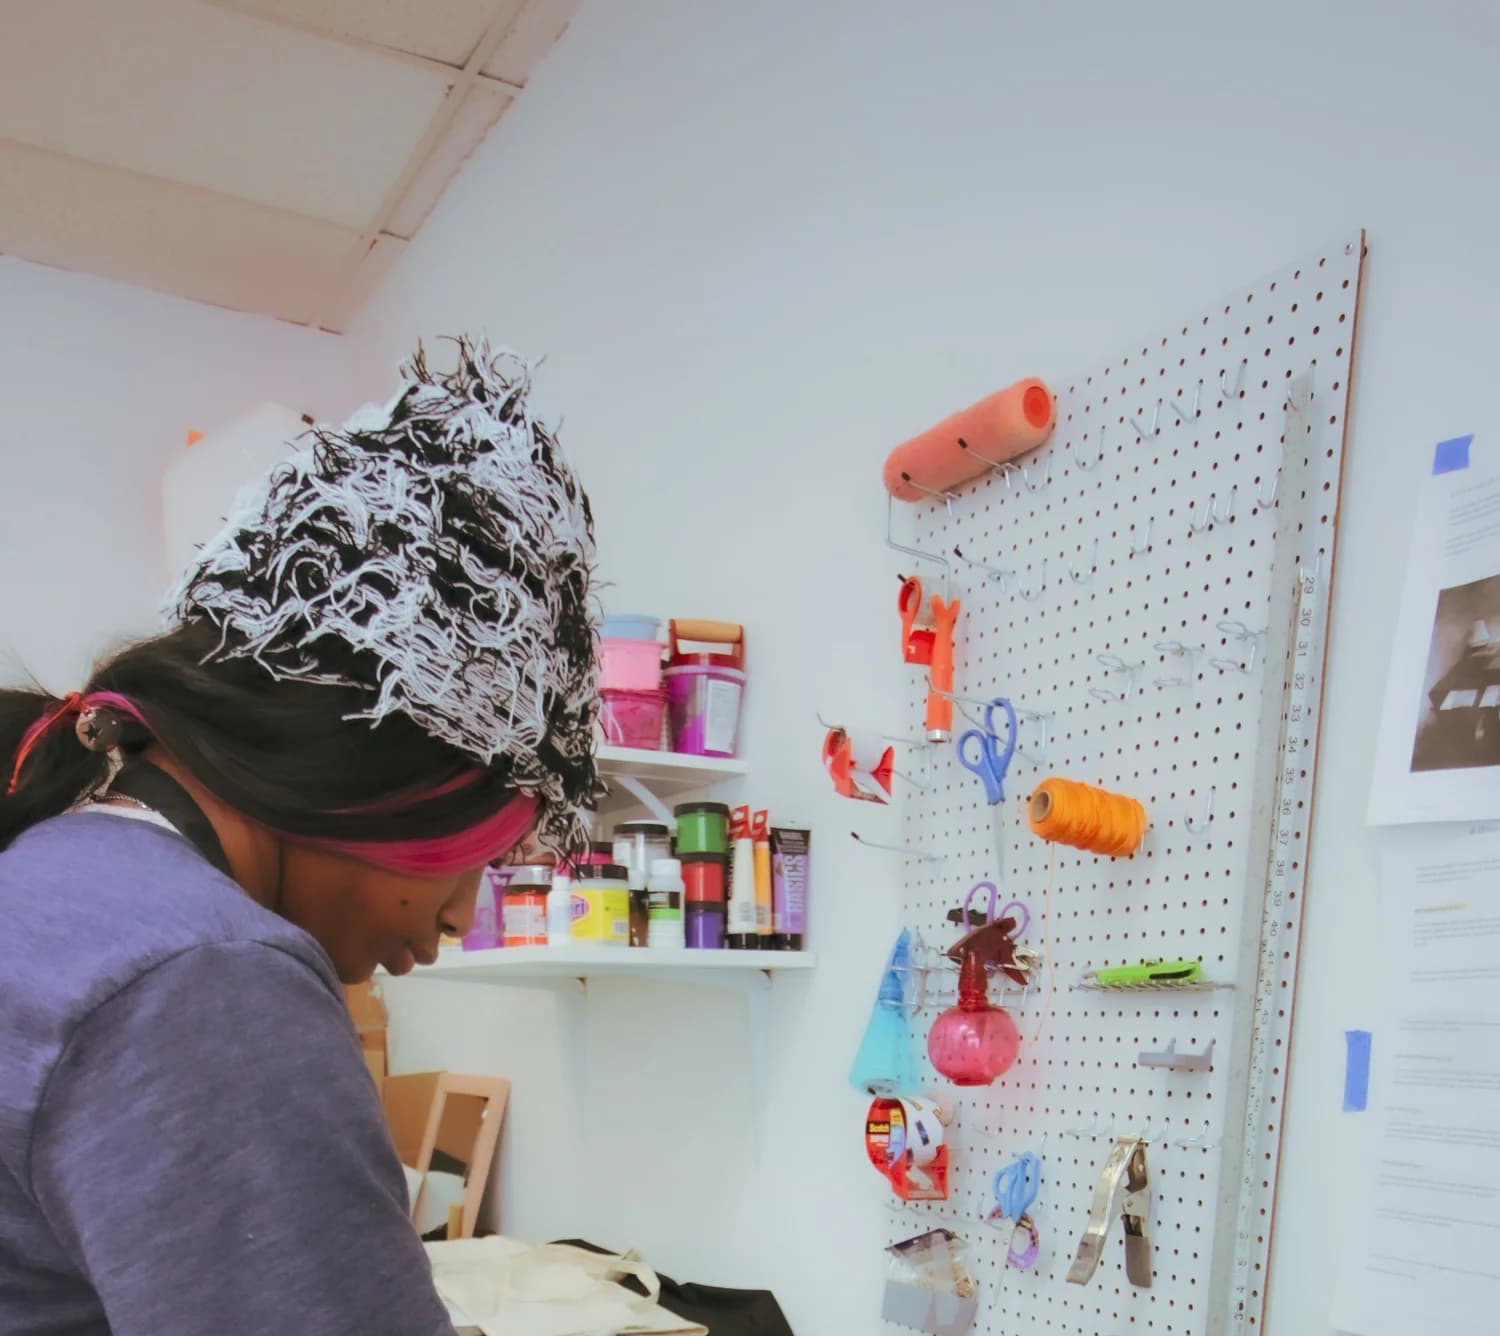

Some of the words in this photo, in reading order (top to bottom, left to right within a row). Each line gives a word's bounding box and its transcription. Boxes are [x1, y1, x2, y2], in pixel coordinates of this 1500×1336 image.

[1304, 576, 1315, 595] 29
[1300, 608, 1312, 626] 30
[1298, 641, 1308, 657] 31
[1294, 673, 1305, 690] 32
[1291, 704, 1302, 722] 33
[1288, 736, 1298, 753] 34
[1285, 768, 1295, 785] 35
[1282, 799, 1292, 816] 36
[1280, 829, 1289, 846] 37
[1270, 919, 1279, 936] 40
